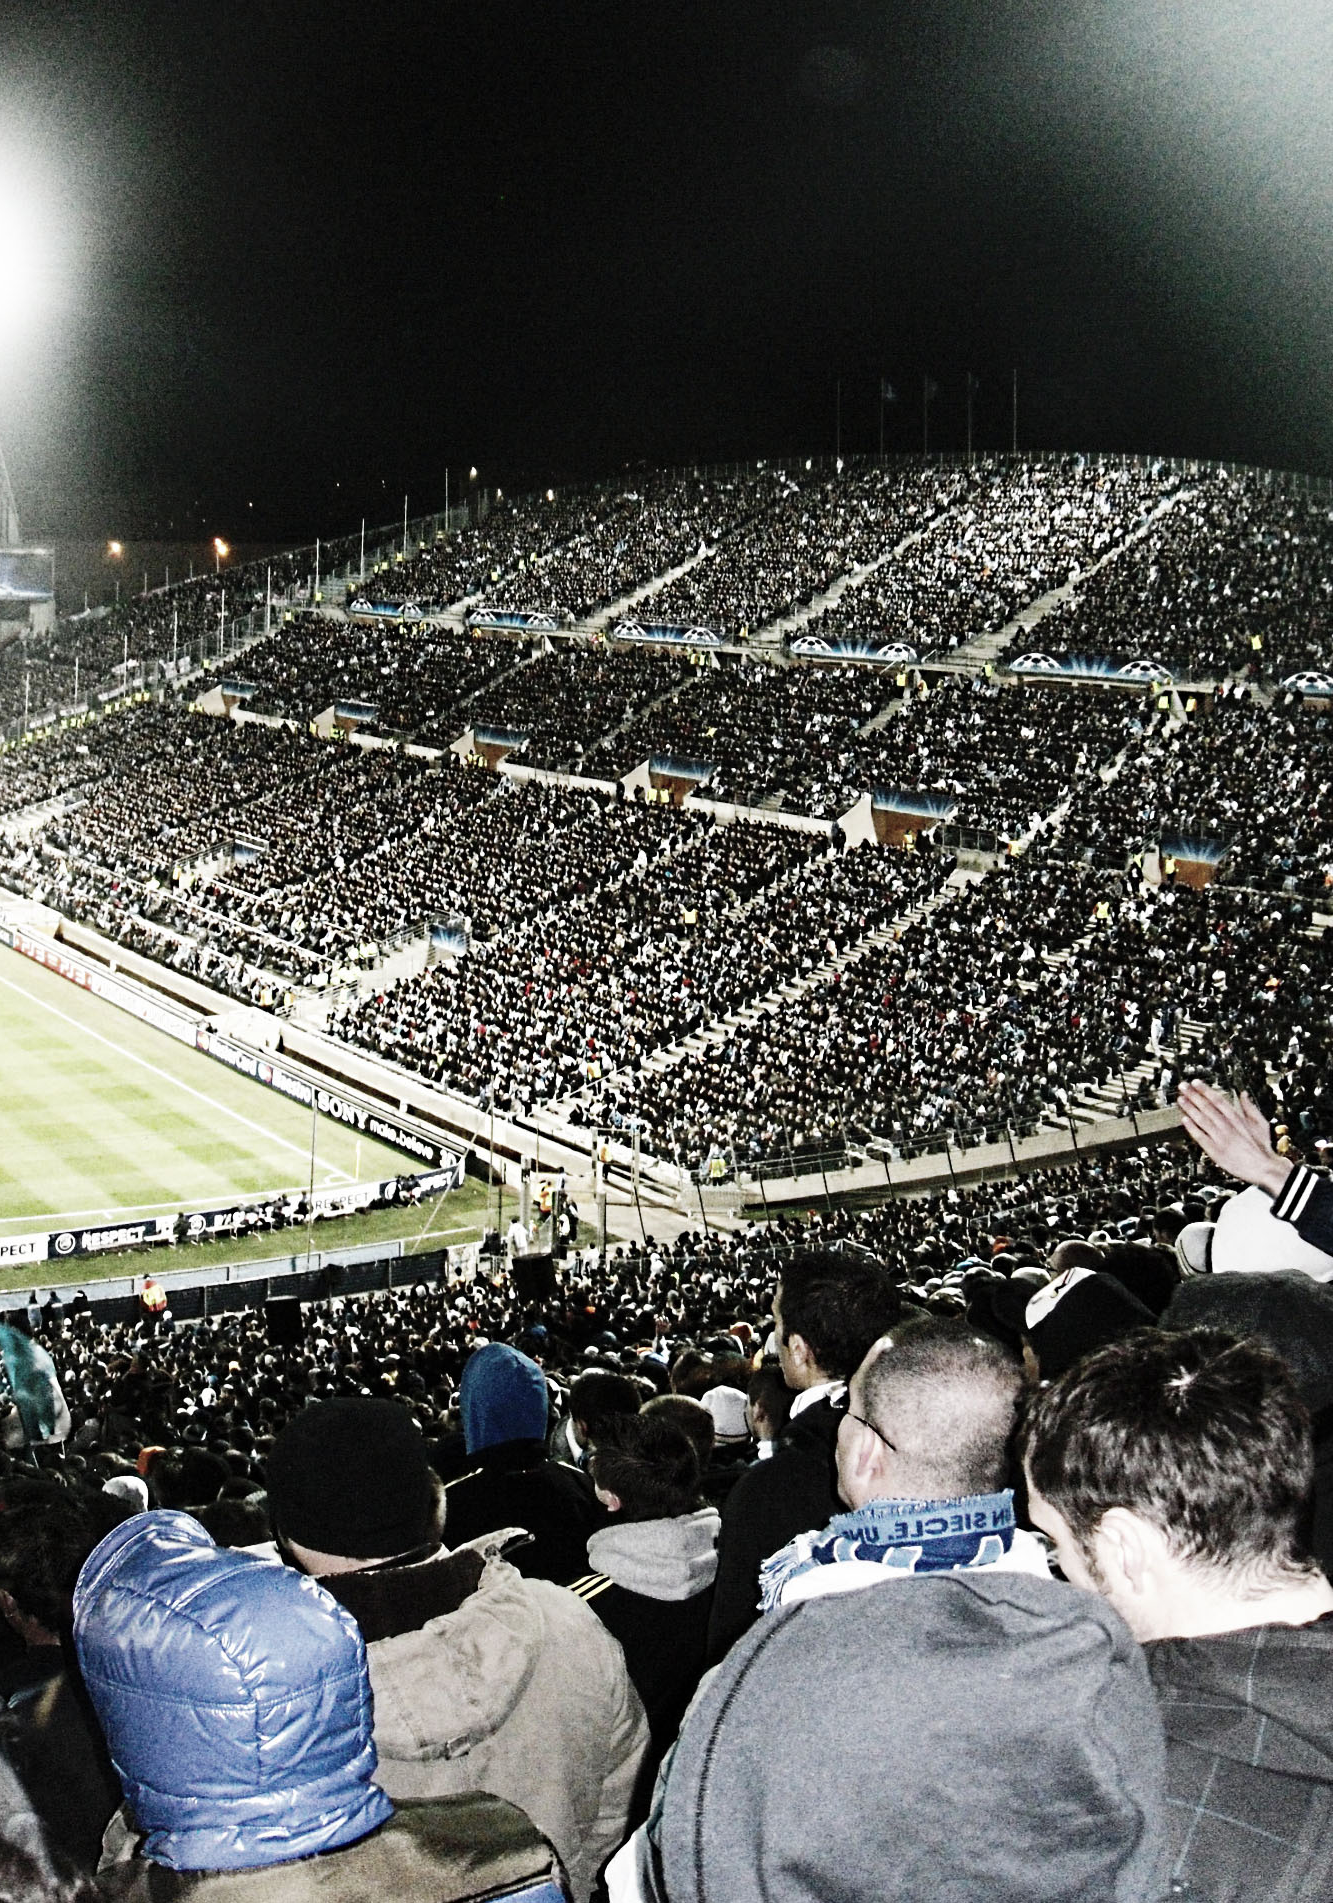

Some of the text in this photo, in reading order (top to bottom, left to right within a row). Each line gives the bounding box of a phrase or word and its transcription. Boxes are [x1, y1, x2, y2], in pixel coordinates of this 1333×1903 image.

[318, 1091, 369, 1129] SONY
[370, 1119, 433, 1160] make.believe
[82, 1225, 146, 1250] RESPECT
